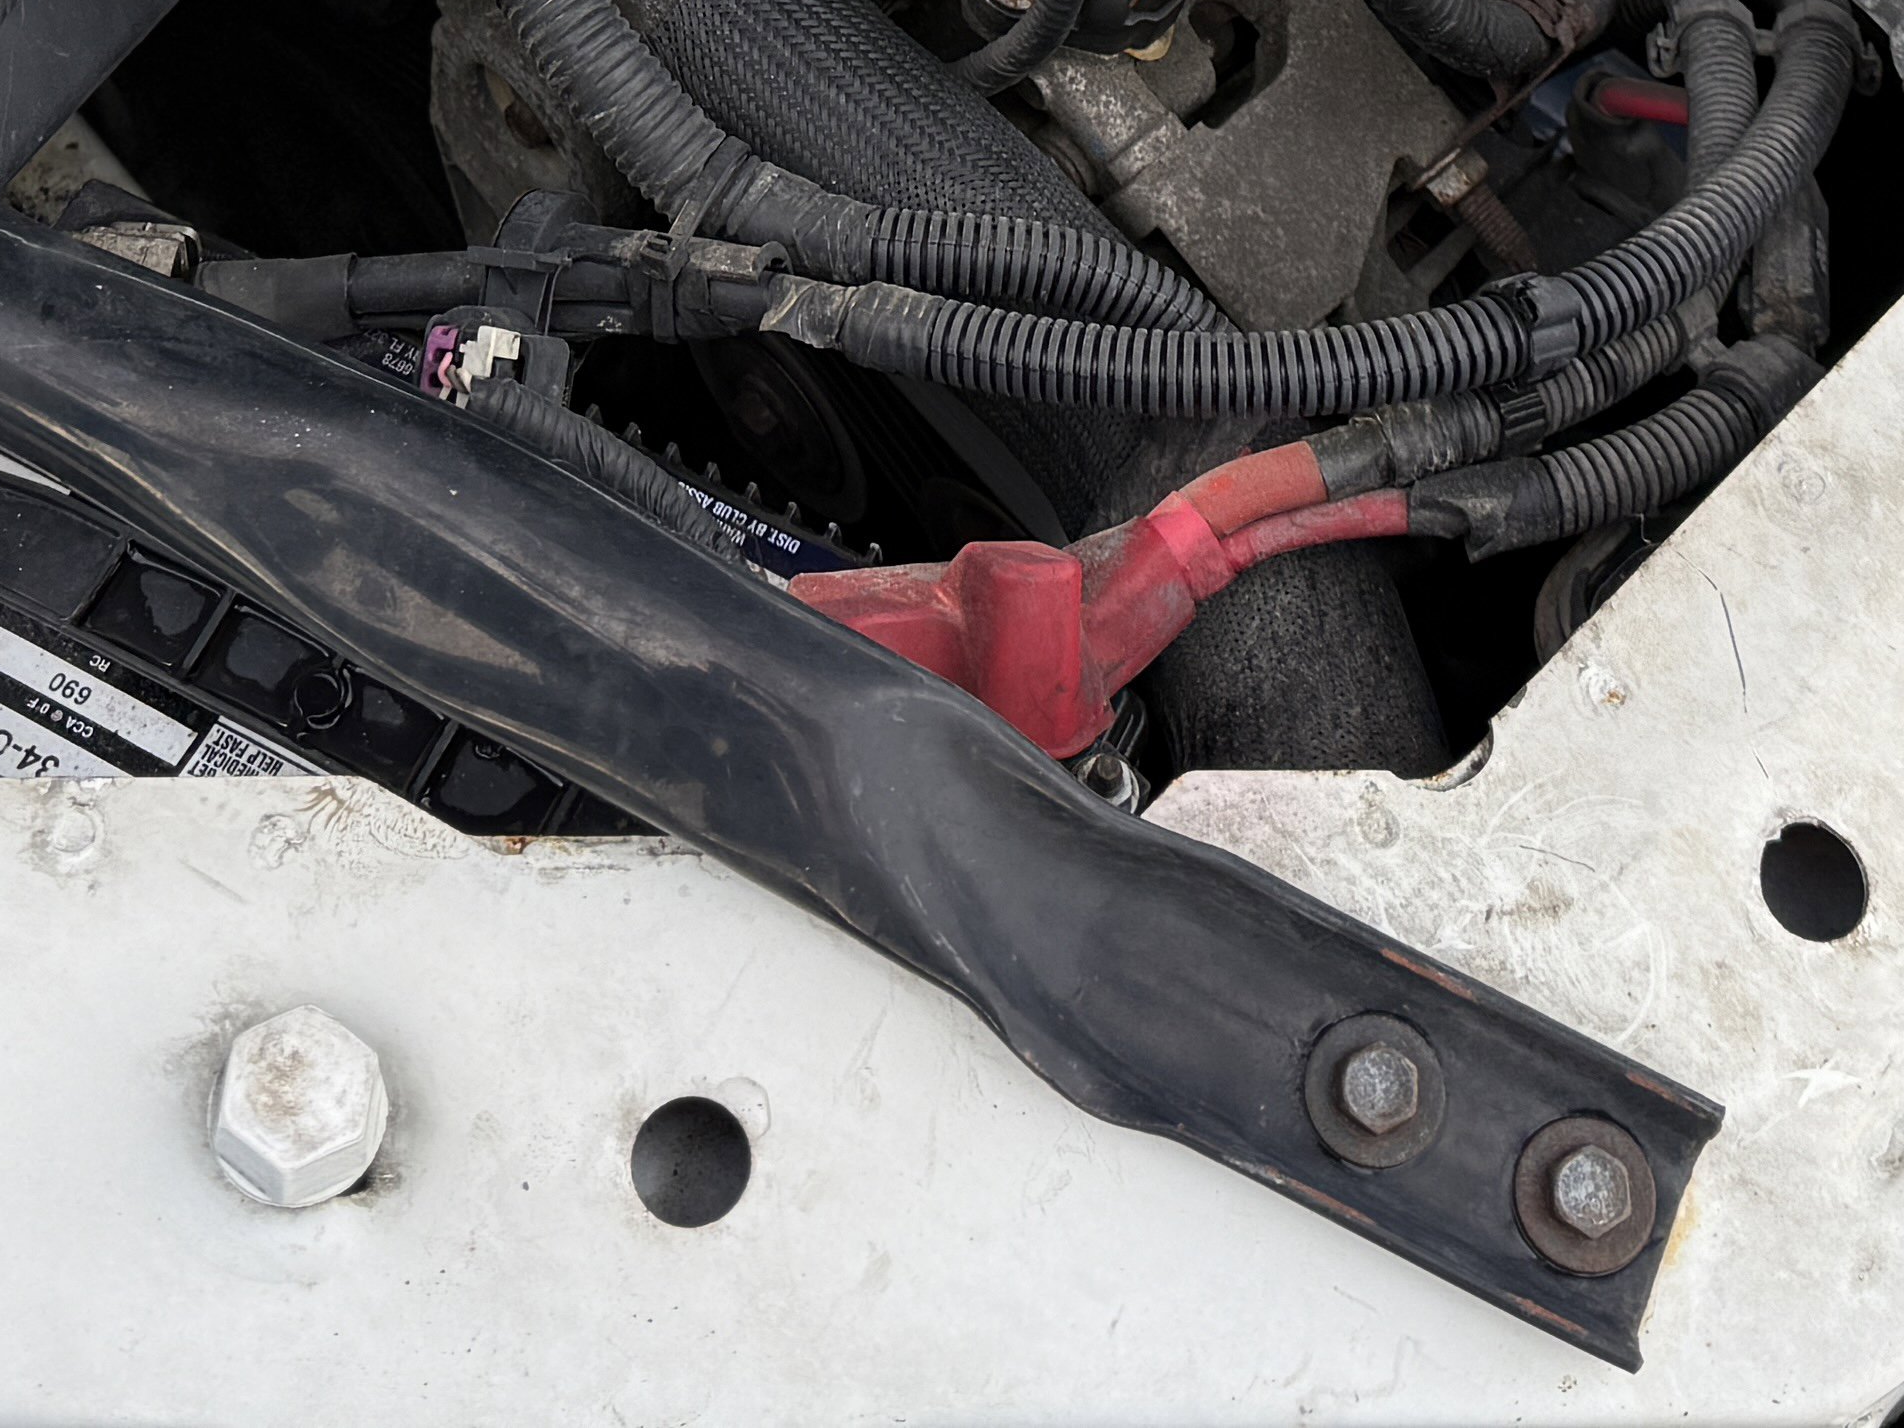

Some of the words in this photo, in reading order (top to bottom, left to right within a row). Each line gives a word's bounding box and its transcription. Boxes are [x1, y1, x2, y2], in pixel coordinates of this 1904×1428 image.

[713, 502, 747, 525] CLUB
[747, 520, 767, 536] BY
[768, 528, 800, 553] DIST.
[90, 655, 110, 672] RC
[49, 673, 92, 705] 690
[66, 716, 93, 737] CCA
[212, 729, 249, 758] FAST.
[247, 750, 283, 776] HELP
